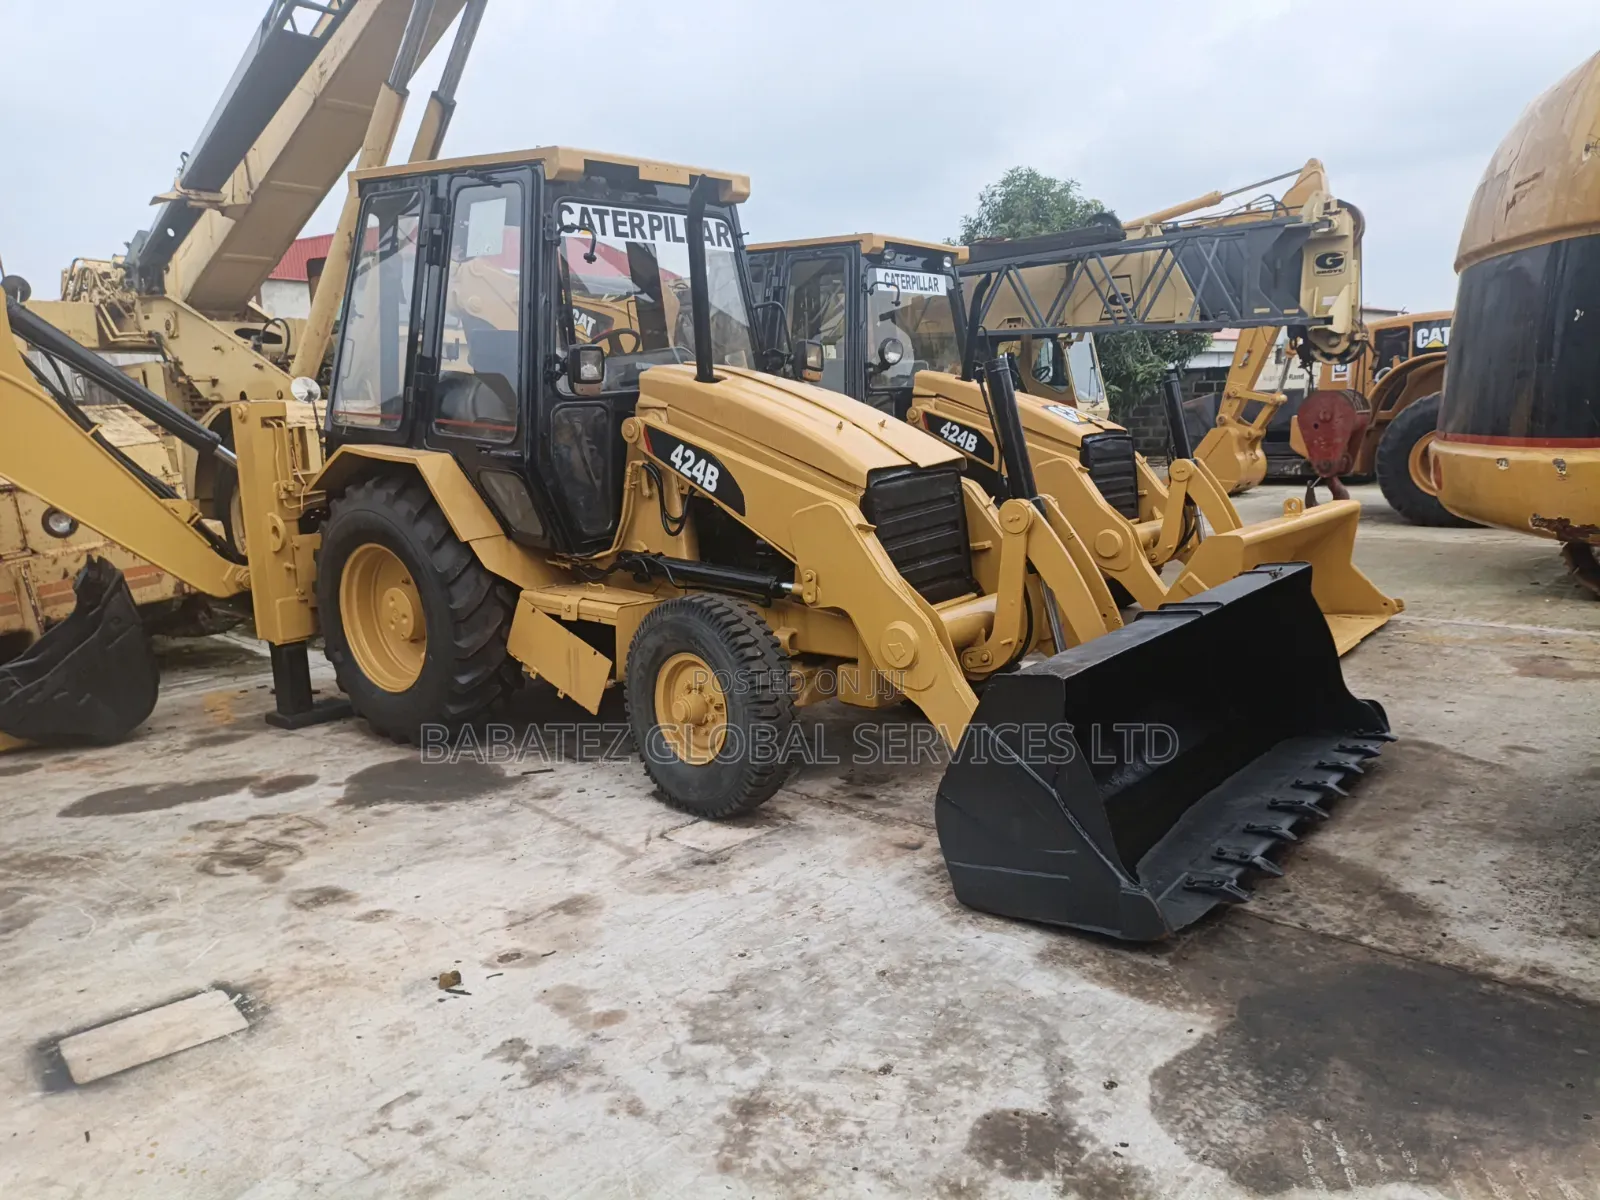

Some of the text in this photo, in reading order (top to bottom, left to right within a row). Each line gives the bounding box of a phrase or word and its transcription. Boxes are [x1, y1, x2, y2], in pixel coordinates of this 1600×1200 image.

[557, 203, 732, 248] CATERPILAR
[884, 272, 939, 293] CATERPILLAR
[1416, 327, 1451, 349] CAT
[940, 421, 978, 453] 424B
[670, 444, 720, 493] 424B
